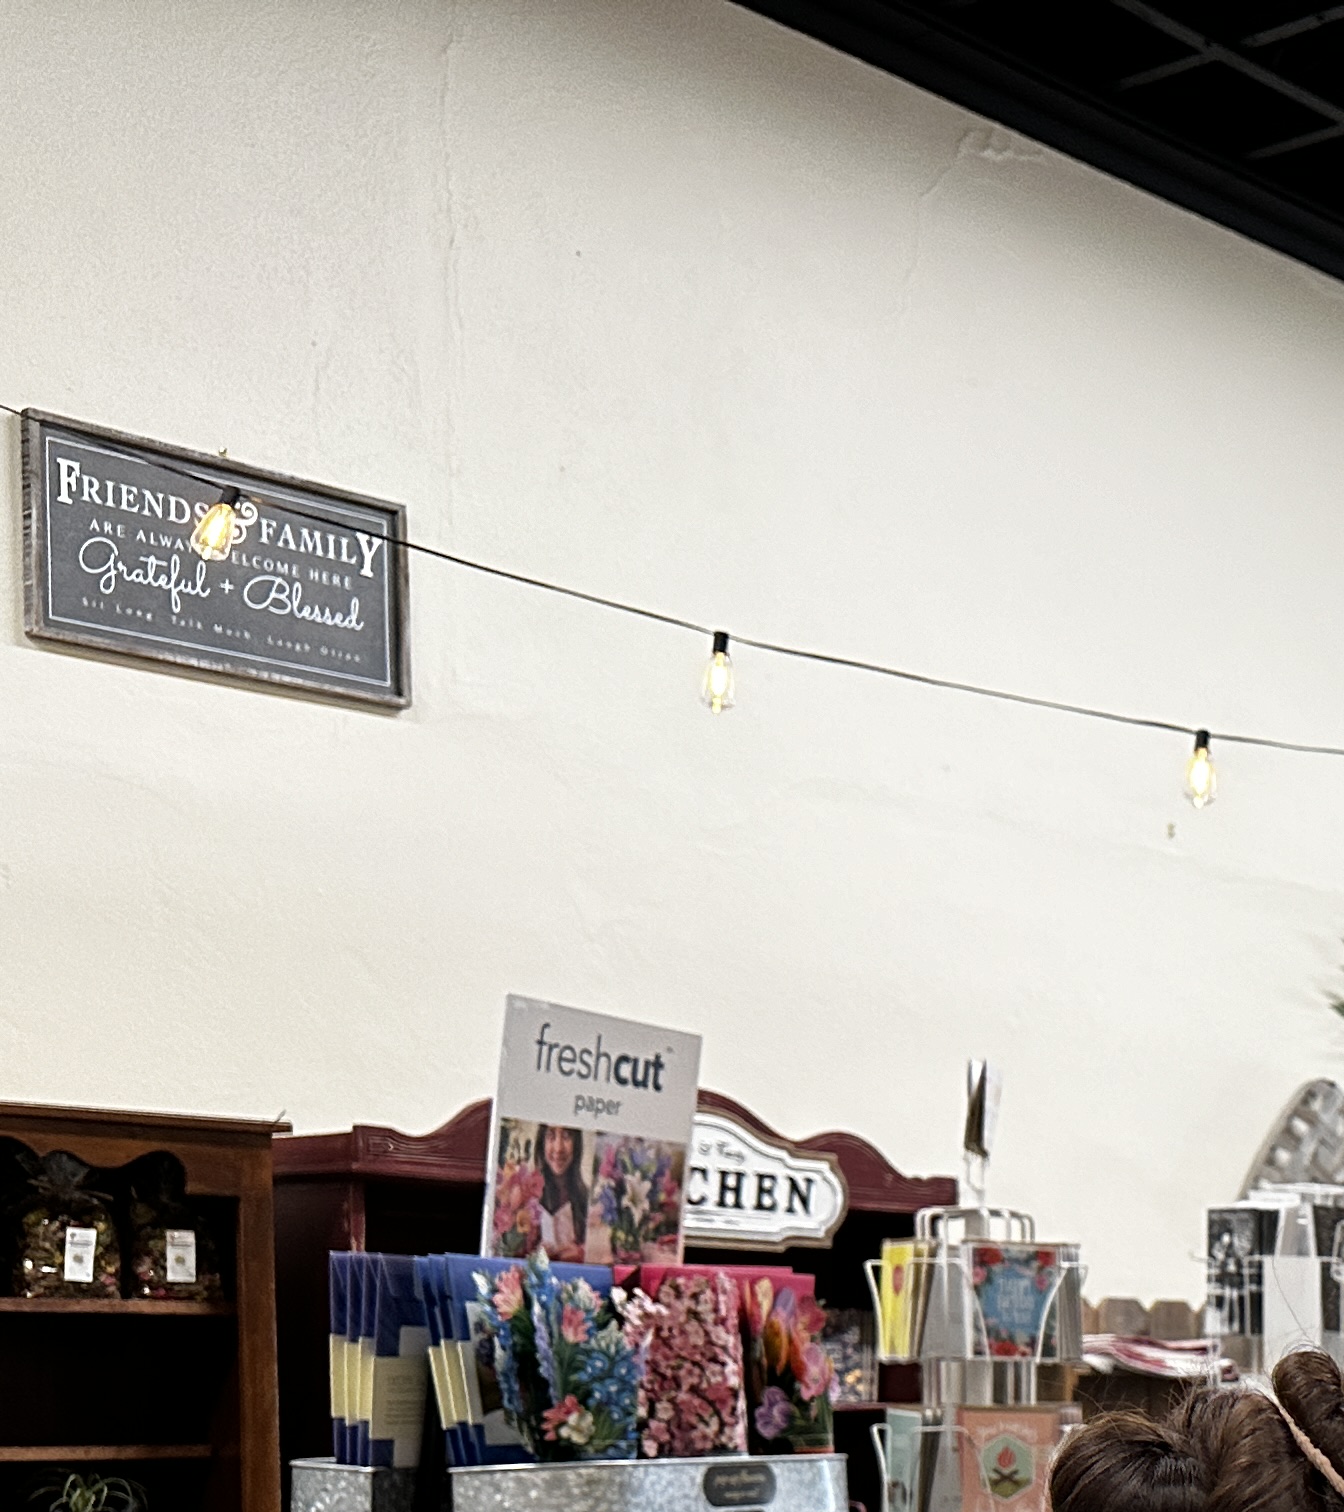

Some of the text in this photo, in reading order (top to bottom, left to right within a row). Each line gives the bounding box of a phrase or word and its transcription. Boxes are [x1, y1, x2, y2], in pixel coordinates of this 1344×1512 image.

[89, 518, 353, 591] ARE ALWAY ELCOME HERE
[258, 517, 384, 578] FAMILY
[79, 537, 210, 613] Grateful
[243, 575, 364, 631] Blessed
[535, 1022, 665, 1093] freshcut
[574, 1093, 624, 1118] paper
[686, 1165, 814, 1216] CHEN
